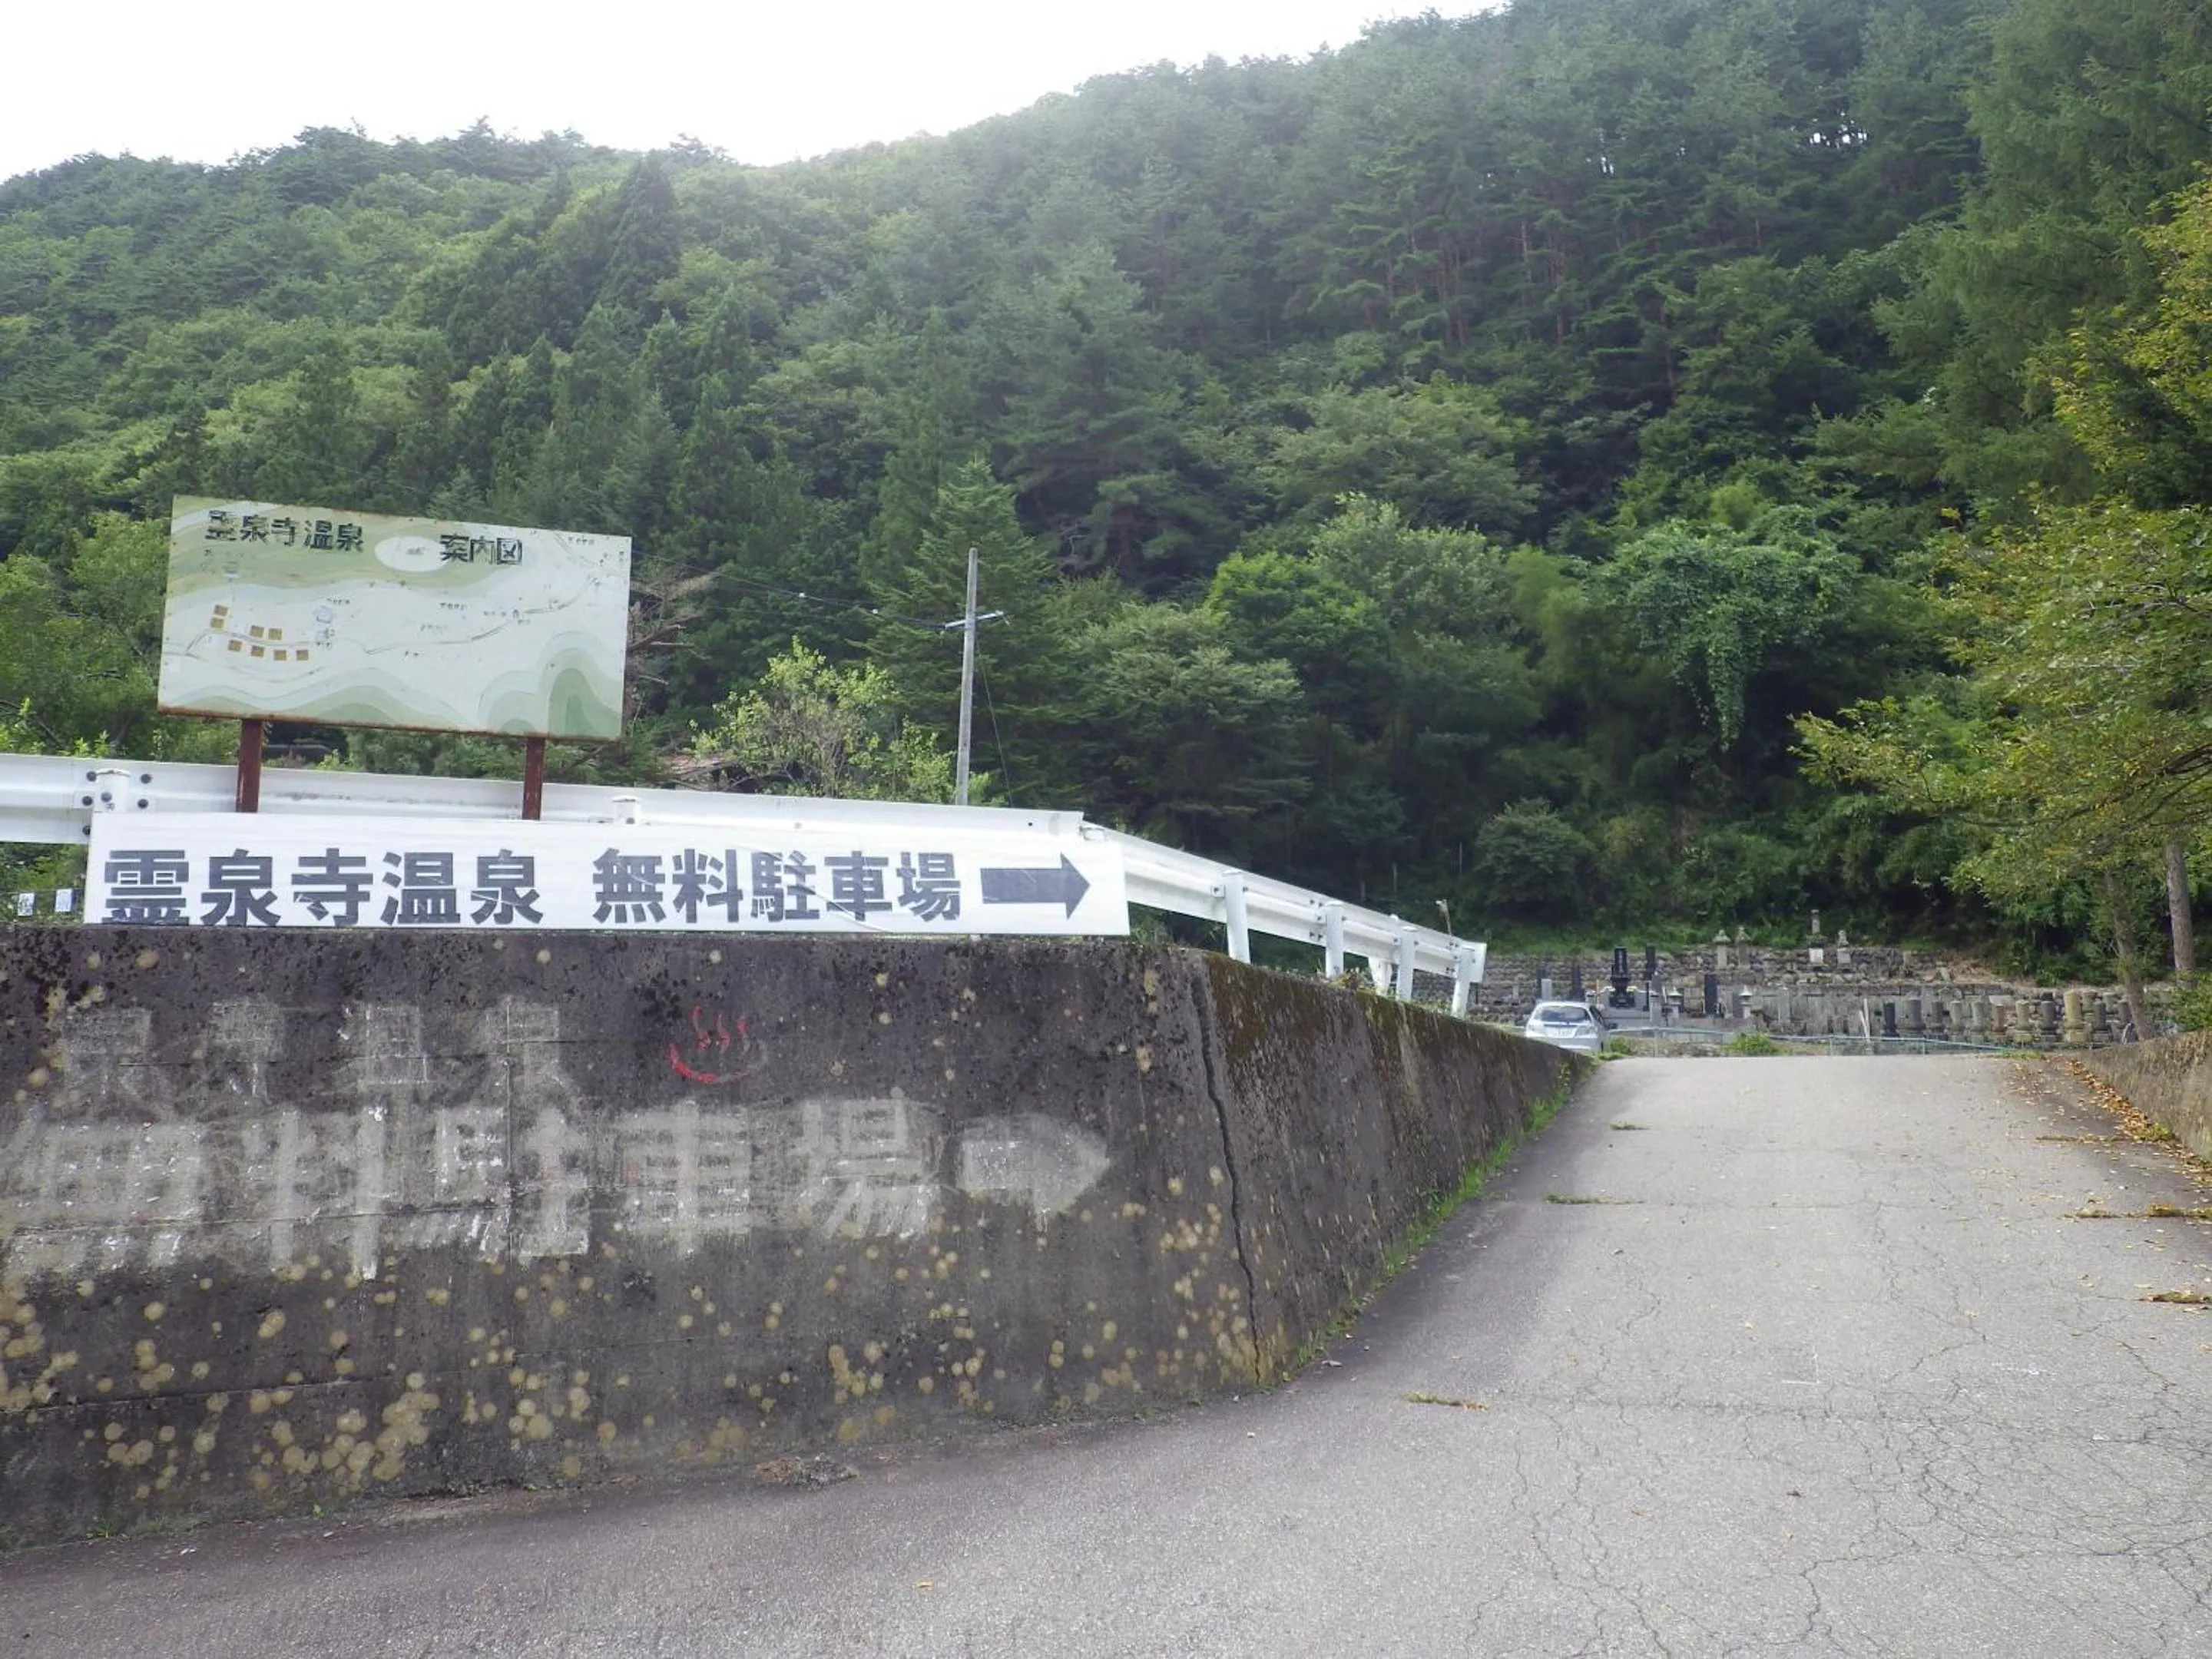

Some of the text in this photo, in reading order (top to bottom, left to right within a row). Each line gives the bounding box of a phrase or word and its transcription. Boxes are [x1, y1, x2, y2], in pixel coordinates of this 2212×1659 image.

[439, 533, 523, 565] 案内図
[102, 847, 962, 926] 霊泉寺温泉 無料駐車場
